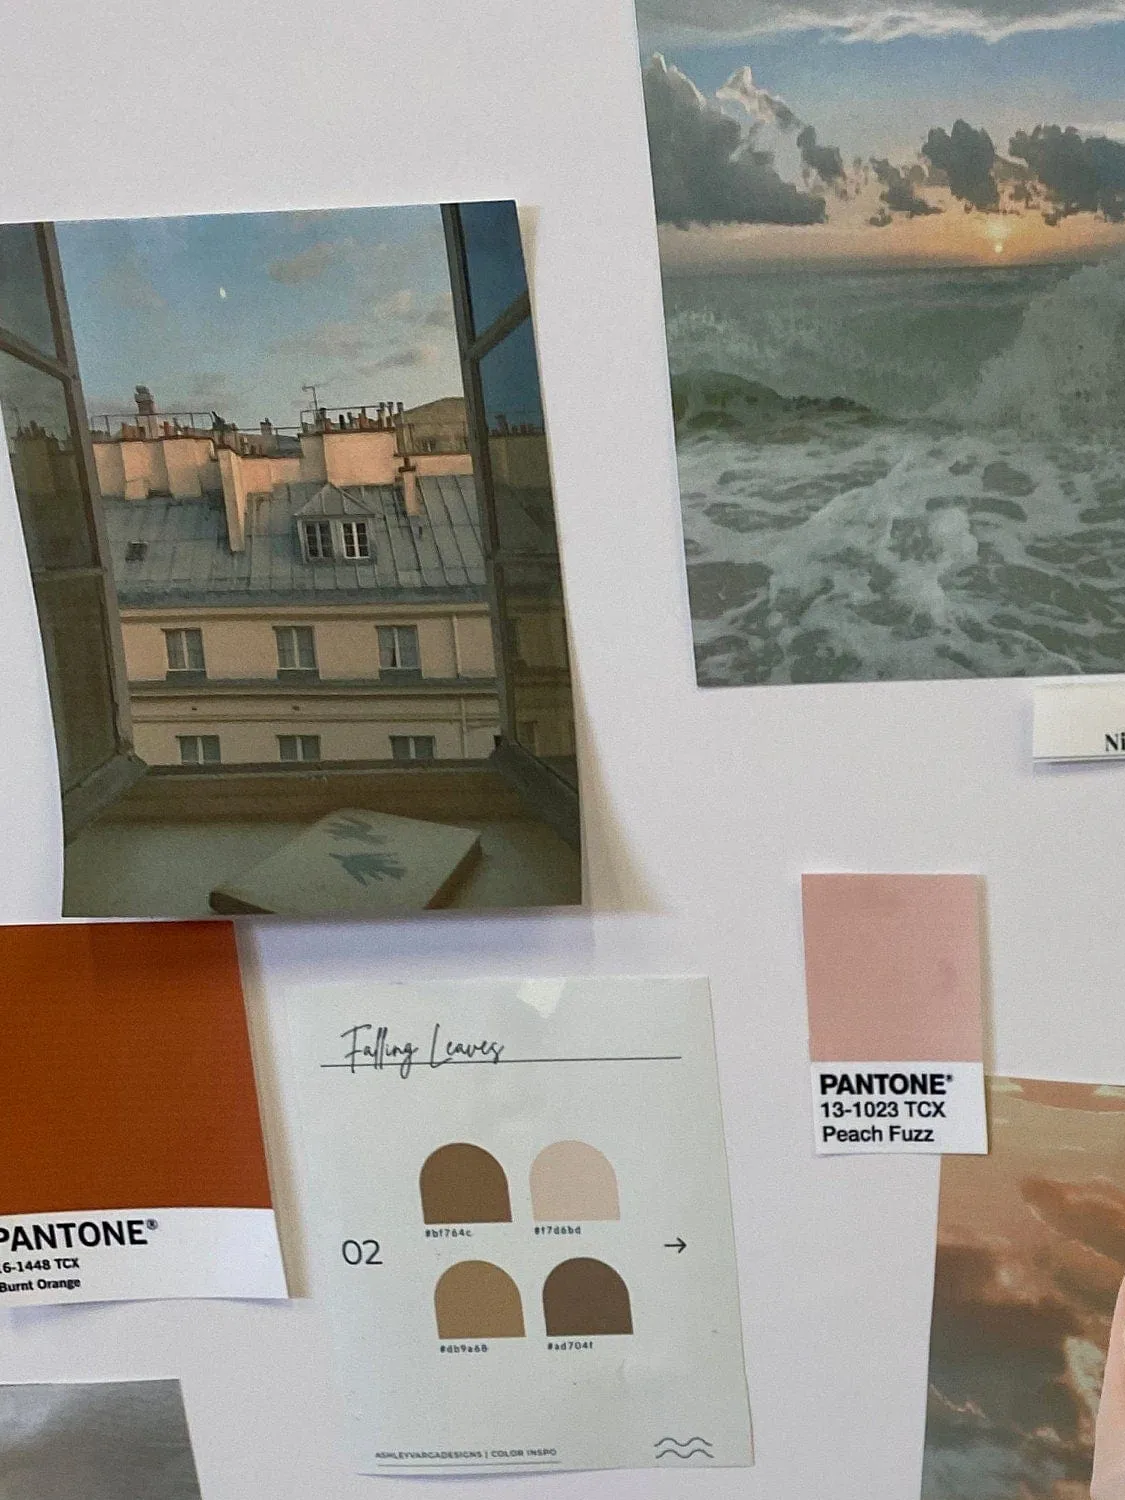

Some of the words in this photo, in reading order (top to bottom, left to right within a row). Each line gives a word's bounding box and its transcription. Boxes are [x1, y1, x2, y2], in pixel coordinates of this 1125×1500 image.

[341, 1024, 419, 1079] Falling
[430, 1023, 505, 1068] Leaves
[821, 1101, 899, 1118] 13-1023
[904, 1101, 946, 1118] TCX
[823, 1126, 883, 1143] Peach
[889, 1126, 935, 1142] Fuzz
[341, 1239, 383, 1266] 02
[0, 1259, 51, 1274] 6-1448
[54, 1257, 80, 1270] TCX
[0, 1280, 34, 1293] Burnt
[37, 1278, 81, 1290] Orange
[491, 1450, 524, 1458] COLOR
